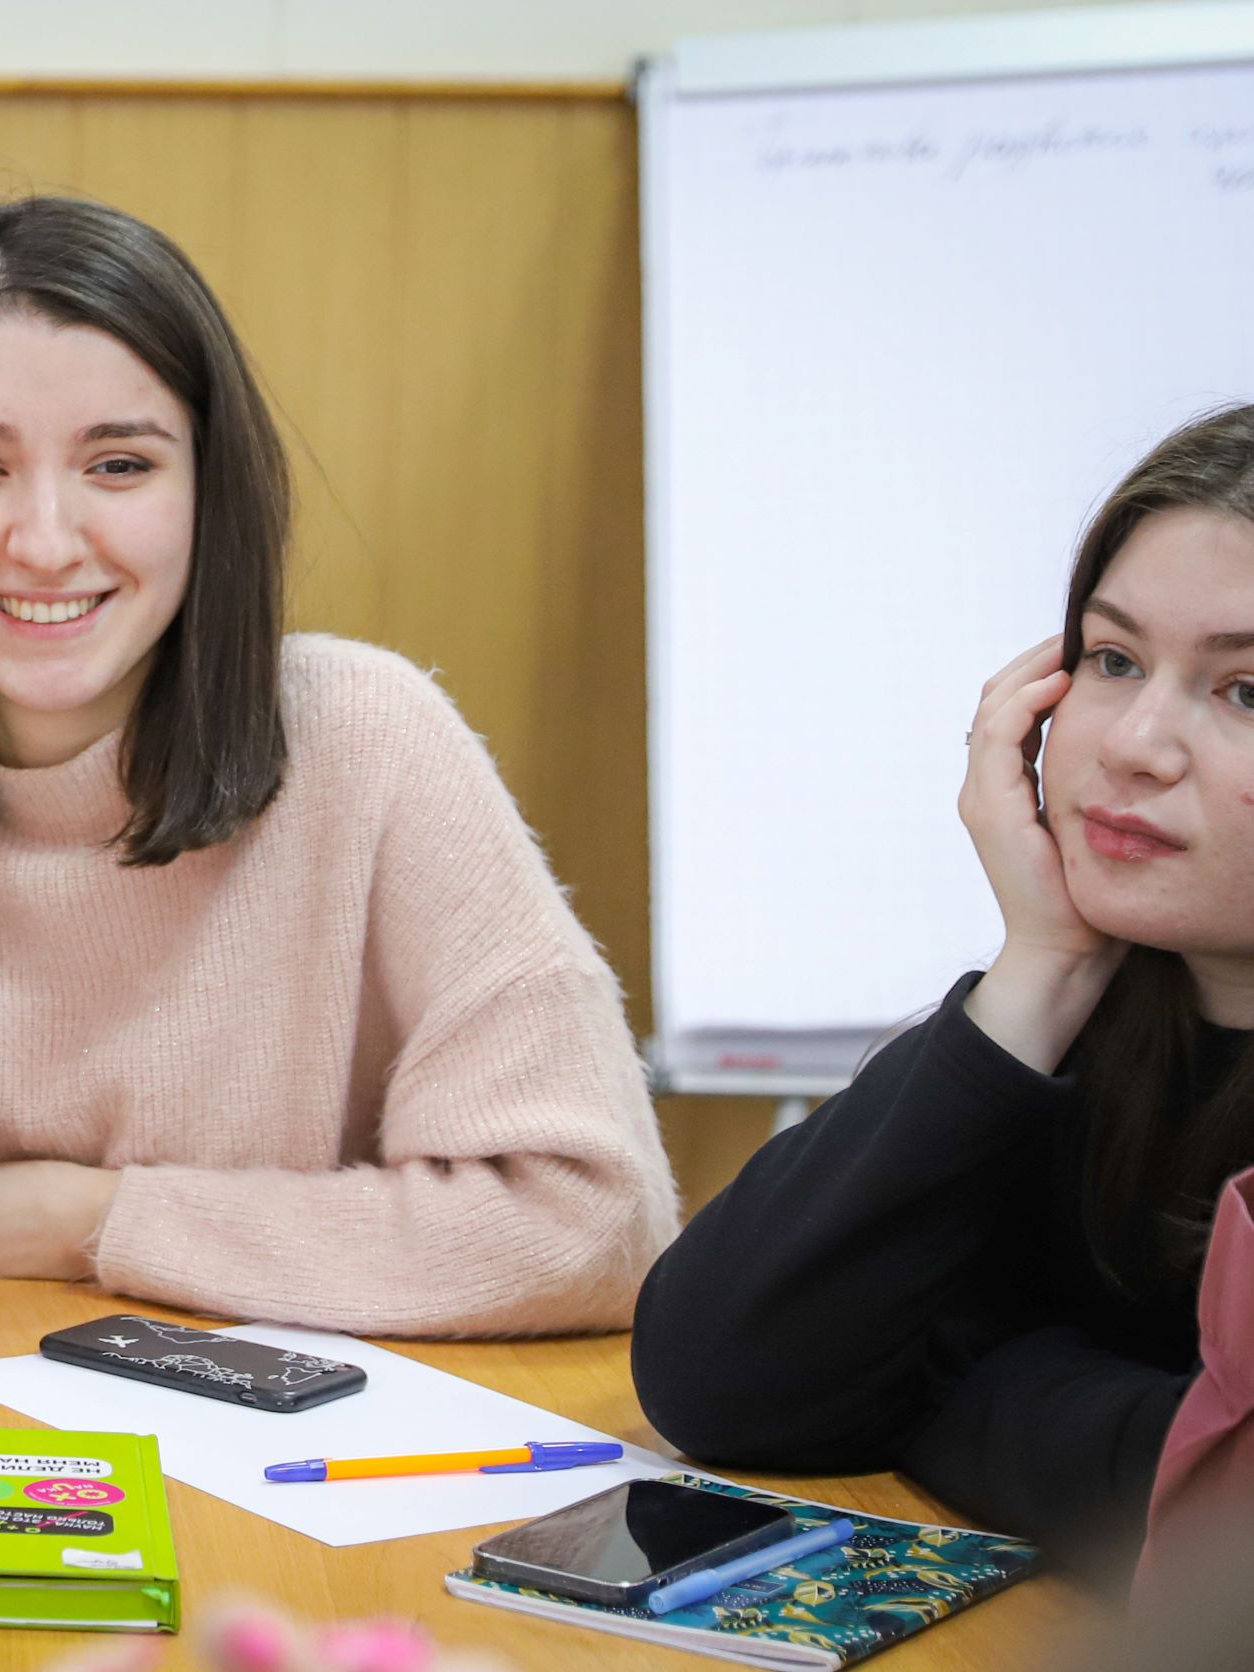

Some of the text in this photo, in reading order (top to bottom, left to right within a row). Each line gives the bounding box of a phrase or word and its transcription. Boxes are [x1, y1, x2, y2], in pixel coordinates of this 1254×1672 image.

[36, 1459, 100, 1467] МЕНЯ
[0, 1464, 64, 1472] ДЕЛИ
[54, 1521, 104, 1531] НАУКА
